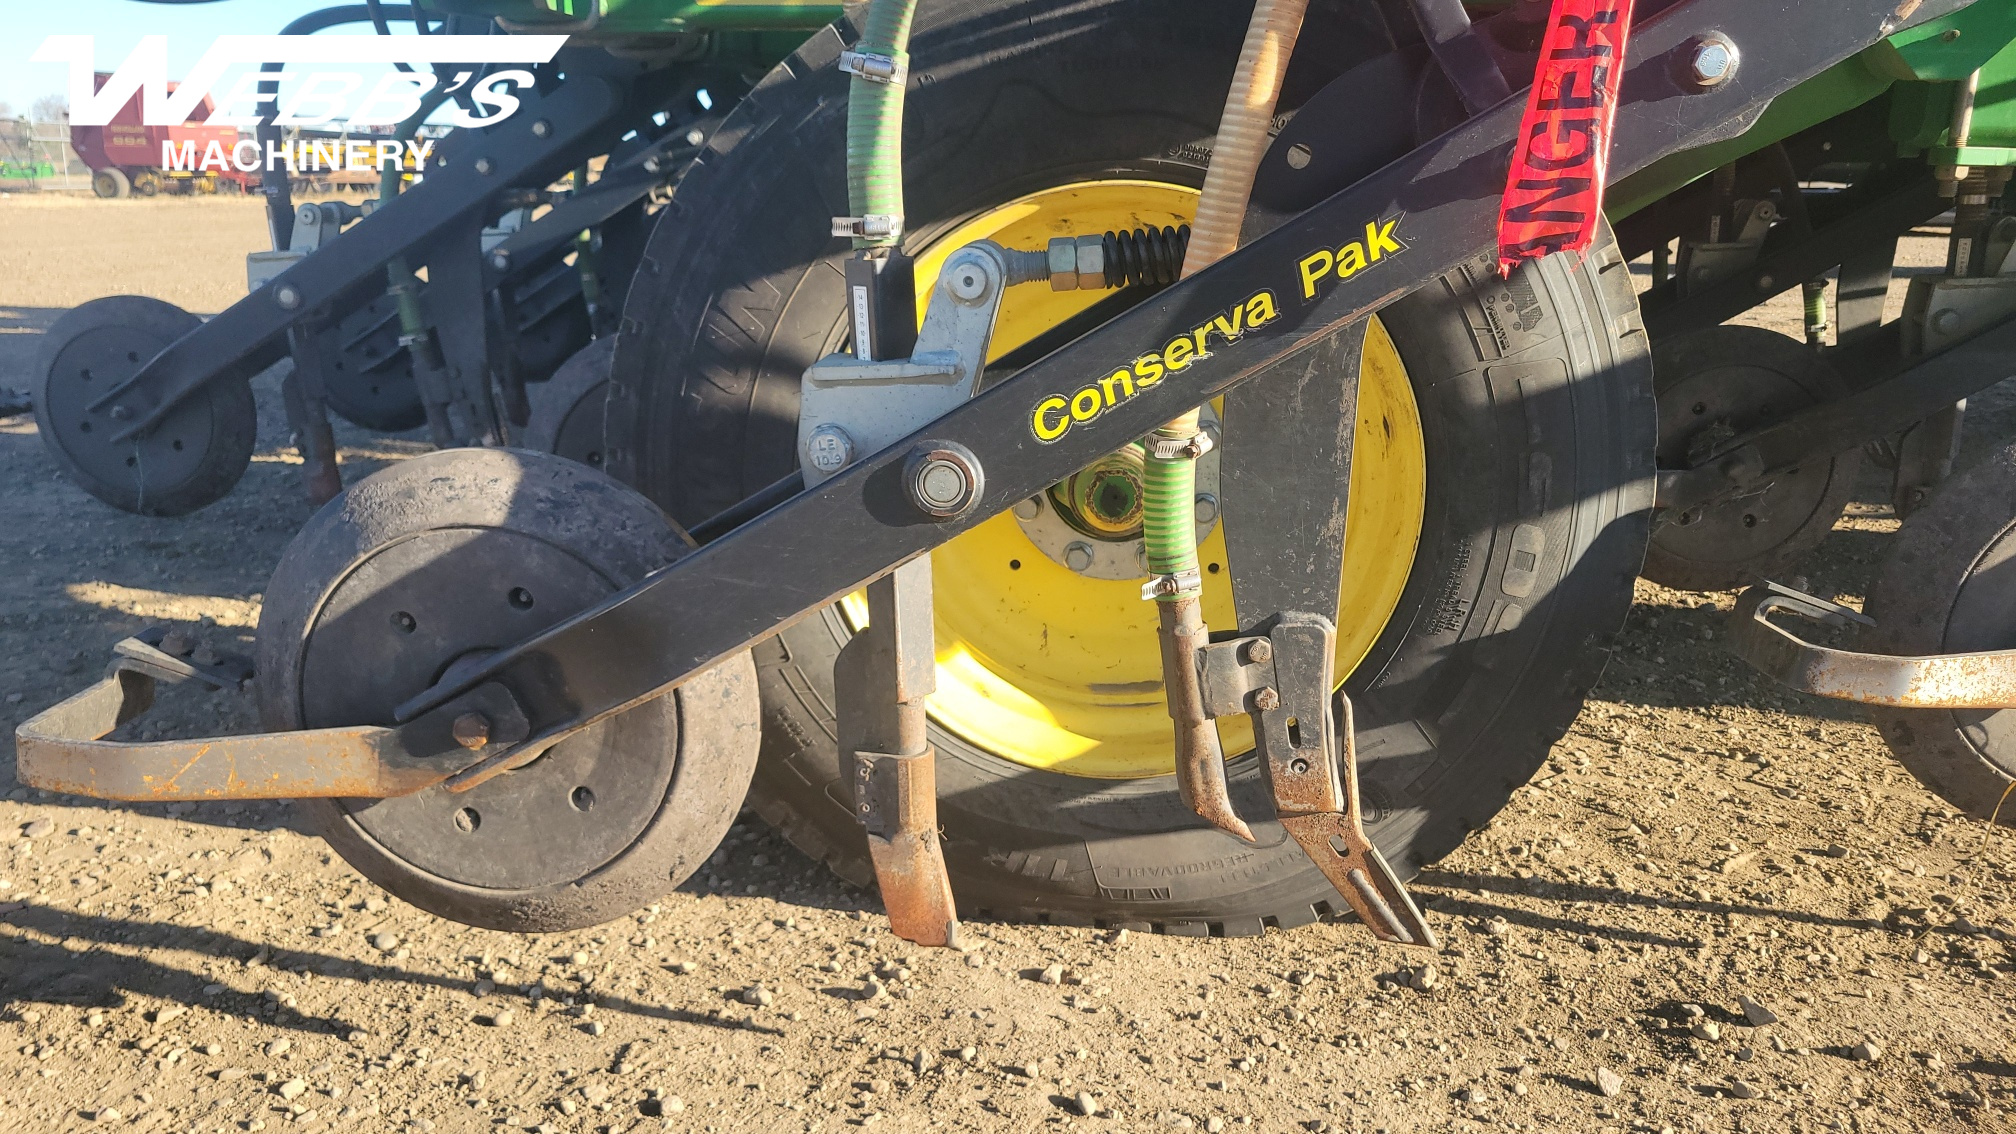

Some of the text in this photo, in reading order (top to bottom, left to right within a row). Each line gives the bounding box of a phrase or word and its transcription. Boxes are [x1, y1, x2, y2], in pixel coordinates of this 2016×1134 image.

[1033, 220, 1399, 441] Conserva Pak
[818, 438, 836, 451] LE
[816, 453, 842, 467] 10.9
